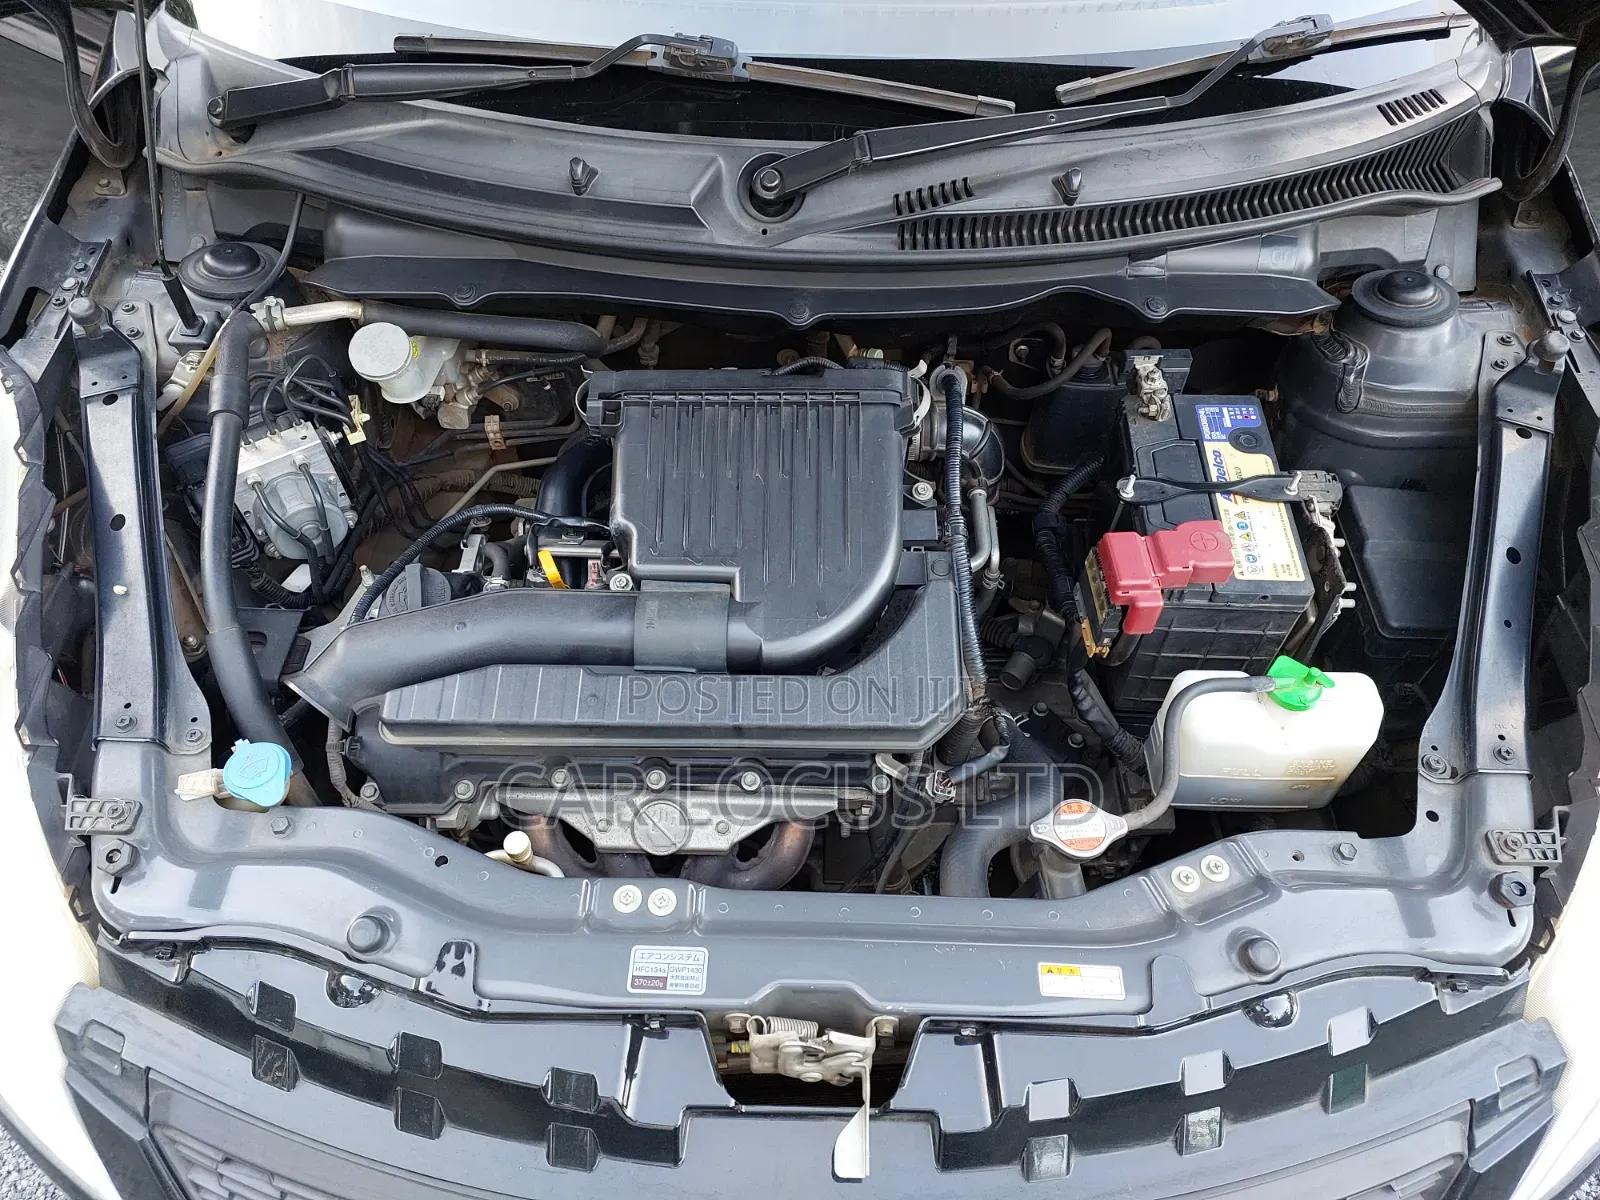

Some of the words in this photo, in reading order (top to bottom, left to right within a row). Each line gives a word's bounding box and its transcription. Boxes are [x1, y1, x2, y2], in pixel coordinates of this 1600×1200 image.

[1212, 450, 1232, 503] ADelco
[1221, 767, 1262, 777] FULL
[1209, 796, 1243, 804] LOW
[639, 951, 700, 962] エアコンシステム
[635, 965, 666, 974] HFC134a
[669, 966, 703, 974] GWP1430
[633, 978, 664, 988] 370±20g
